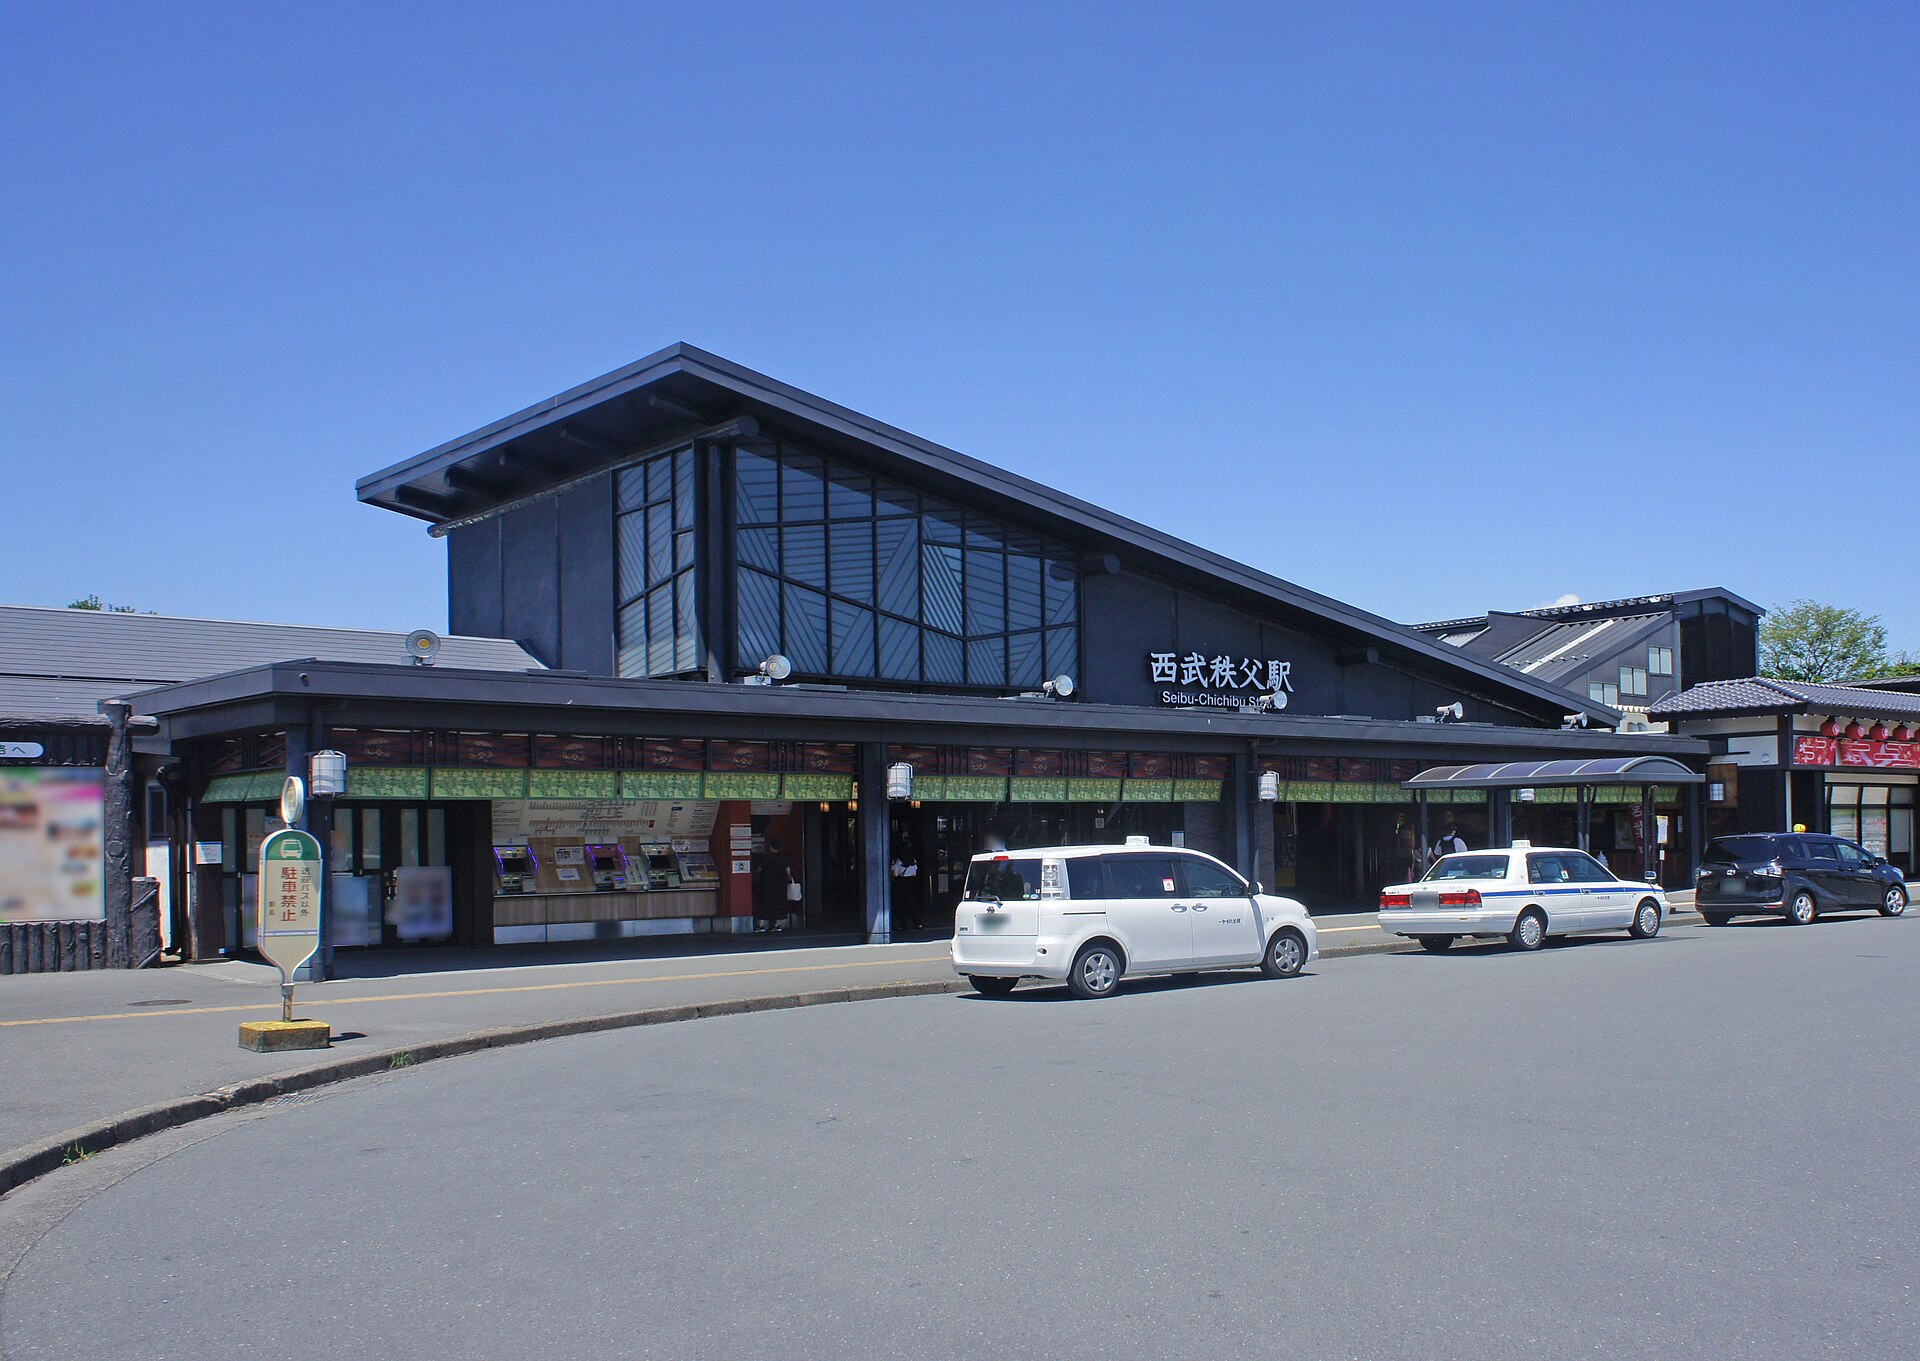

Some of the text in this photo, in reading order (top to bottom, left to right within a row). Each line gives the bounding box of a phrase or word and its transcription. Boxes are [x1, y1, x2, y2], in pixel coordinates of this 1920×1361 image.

[1151, 652, 1294, 692] 西武秩父駅
[1162, 691, 1246, 707] Seibu-Chichibu
[281, 866, 298, 922] 駐車禁止
